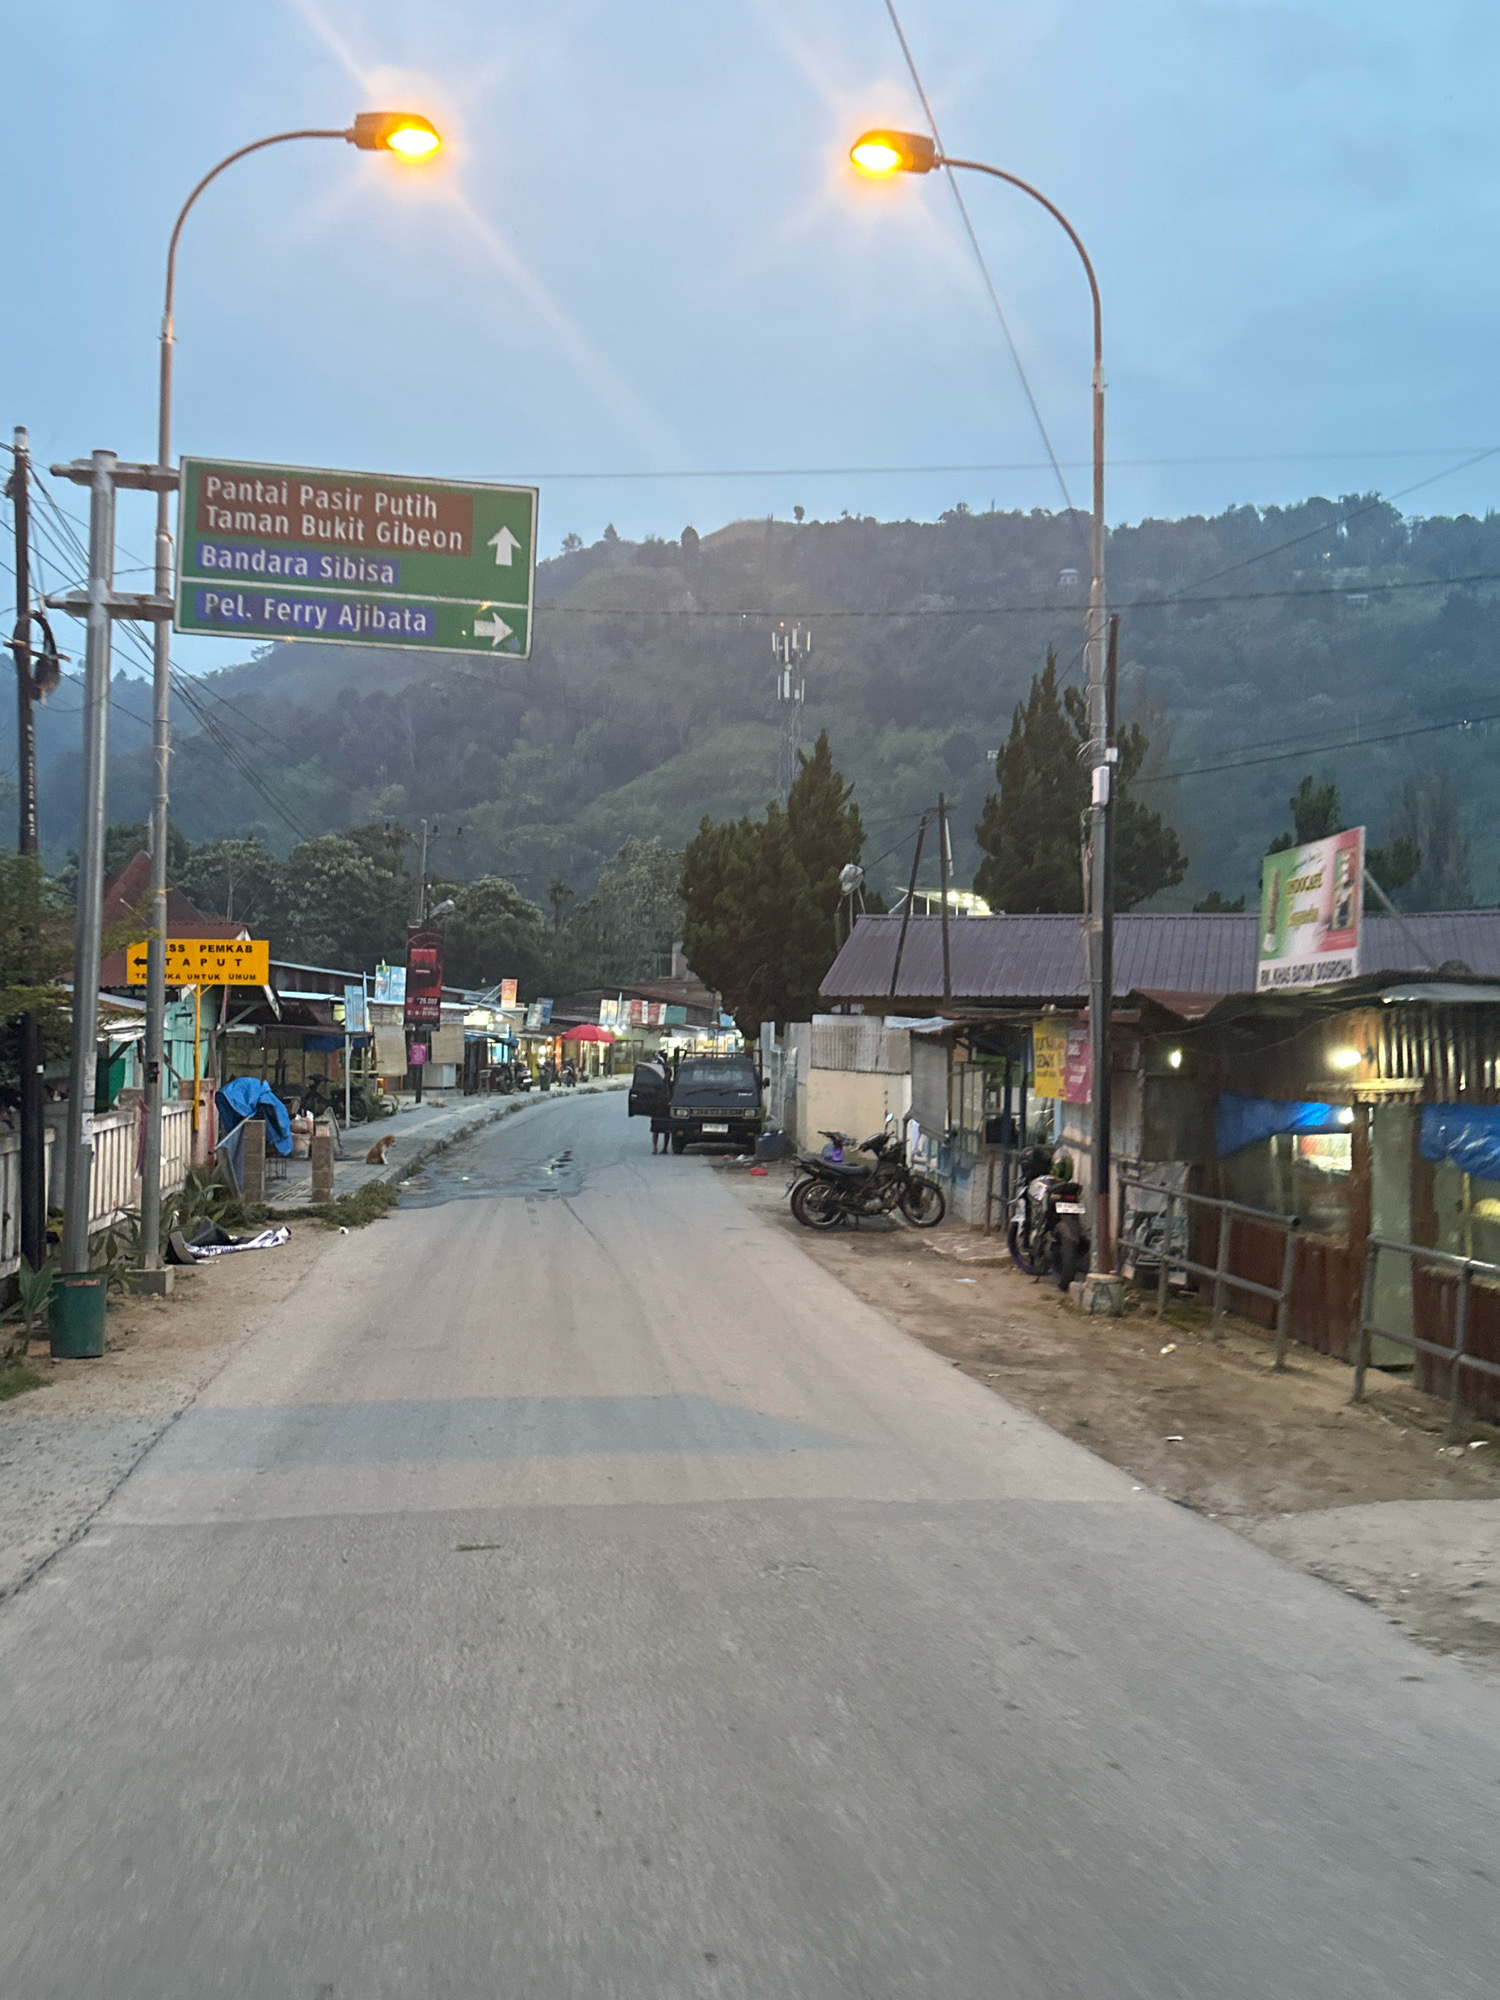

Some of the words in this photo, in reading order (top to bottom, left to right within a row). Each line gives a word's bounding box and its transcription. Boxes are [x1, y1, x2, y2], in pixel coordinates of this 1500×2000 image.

[206, 476, 288, 506] Pantai
[300, 485, 361, 512] Pasir
[375, 492, 438, 519] Putih
[206, 505, 289, 535] Taman
[302, 516, 365, 542] Bukit
[376, 521, 463, 551] Gibeon
[202, 545, 308, 578] Bandara
[320, 556, 395, 585] Sibisa
[204, 593, 252, 619] Pel.
[264, 598, 328, 627] Ferry
[338, 605, 427, 633] Ajibata
[199, 944, 253, 953] PEMKAB
[187, 973, 220, 981] UNTUK
